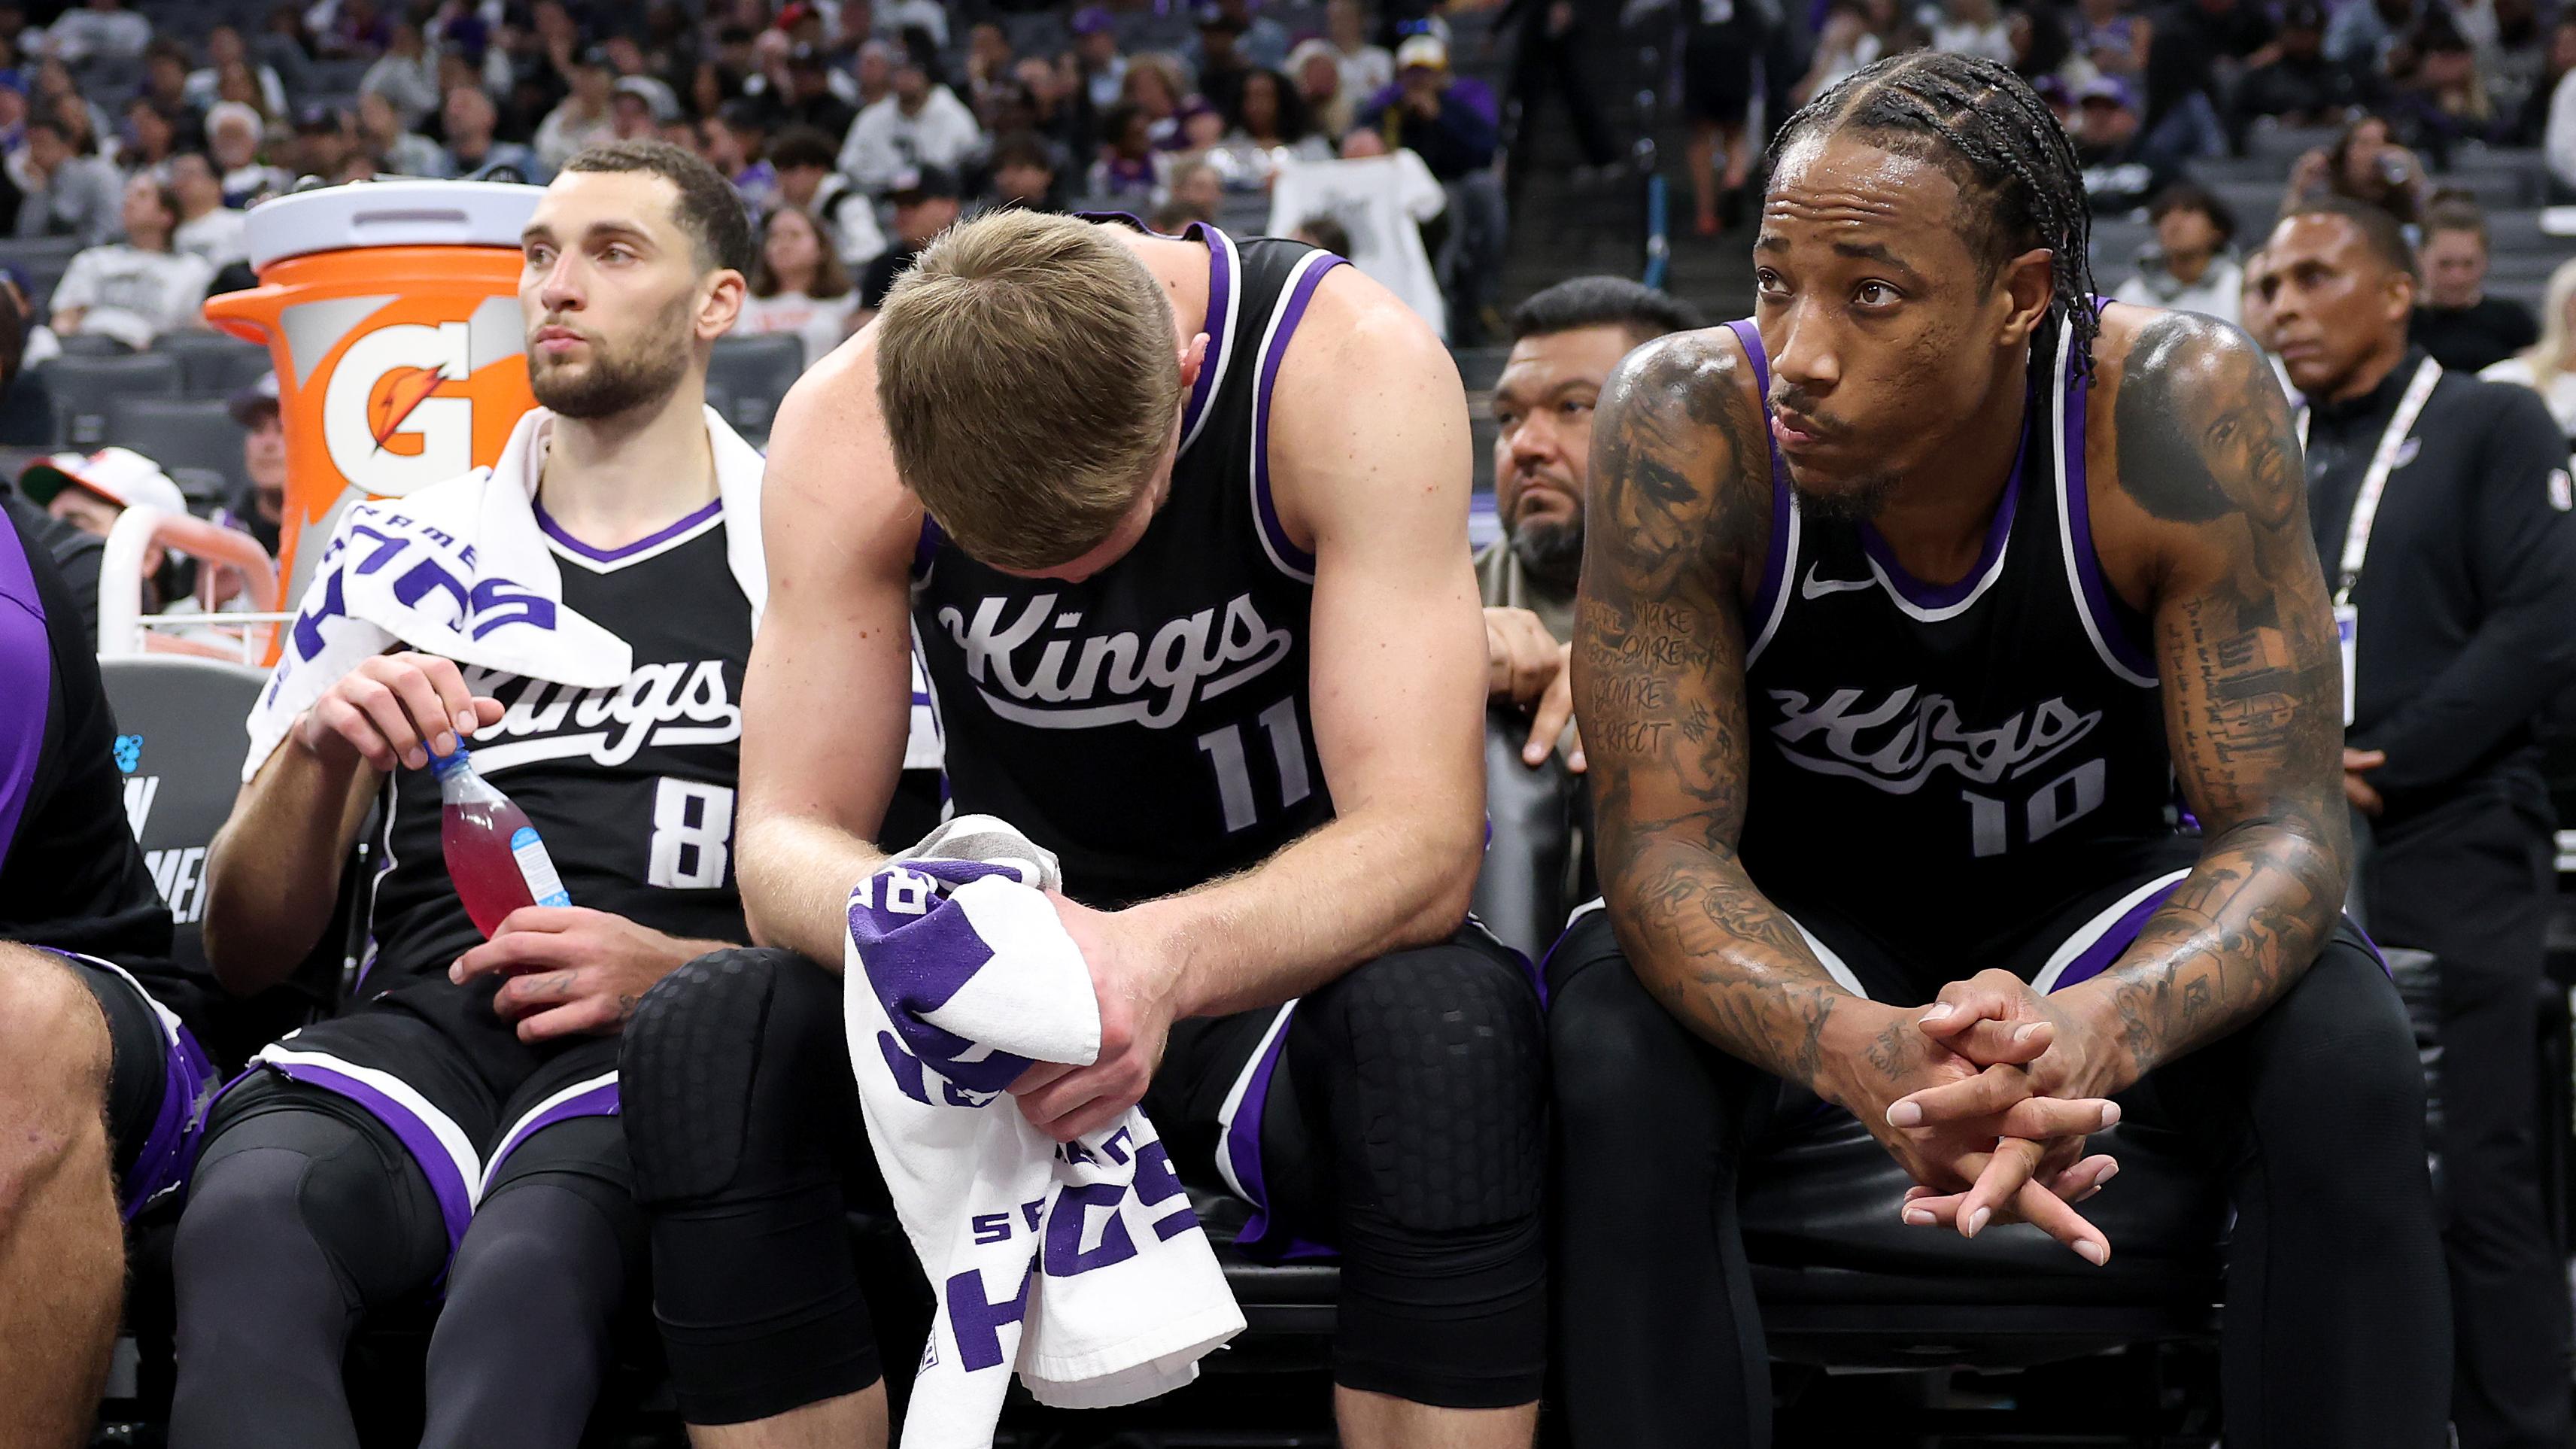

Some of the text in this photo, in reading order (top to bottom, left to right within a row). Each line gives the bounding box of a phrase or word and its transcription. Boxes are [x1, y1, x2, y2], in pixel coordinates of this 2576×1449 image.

[323, 321, 472, 499] G
[938, 593, 1293, 730] Kings
[648, 776, 735, 889] 8
[1198, 695, 1311, 833] 11
[1961, 758, 2106, 858] 10
